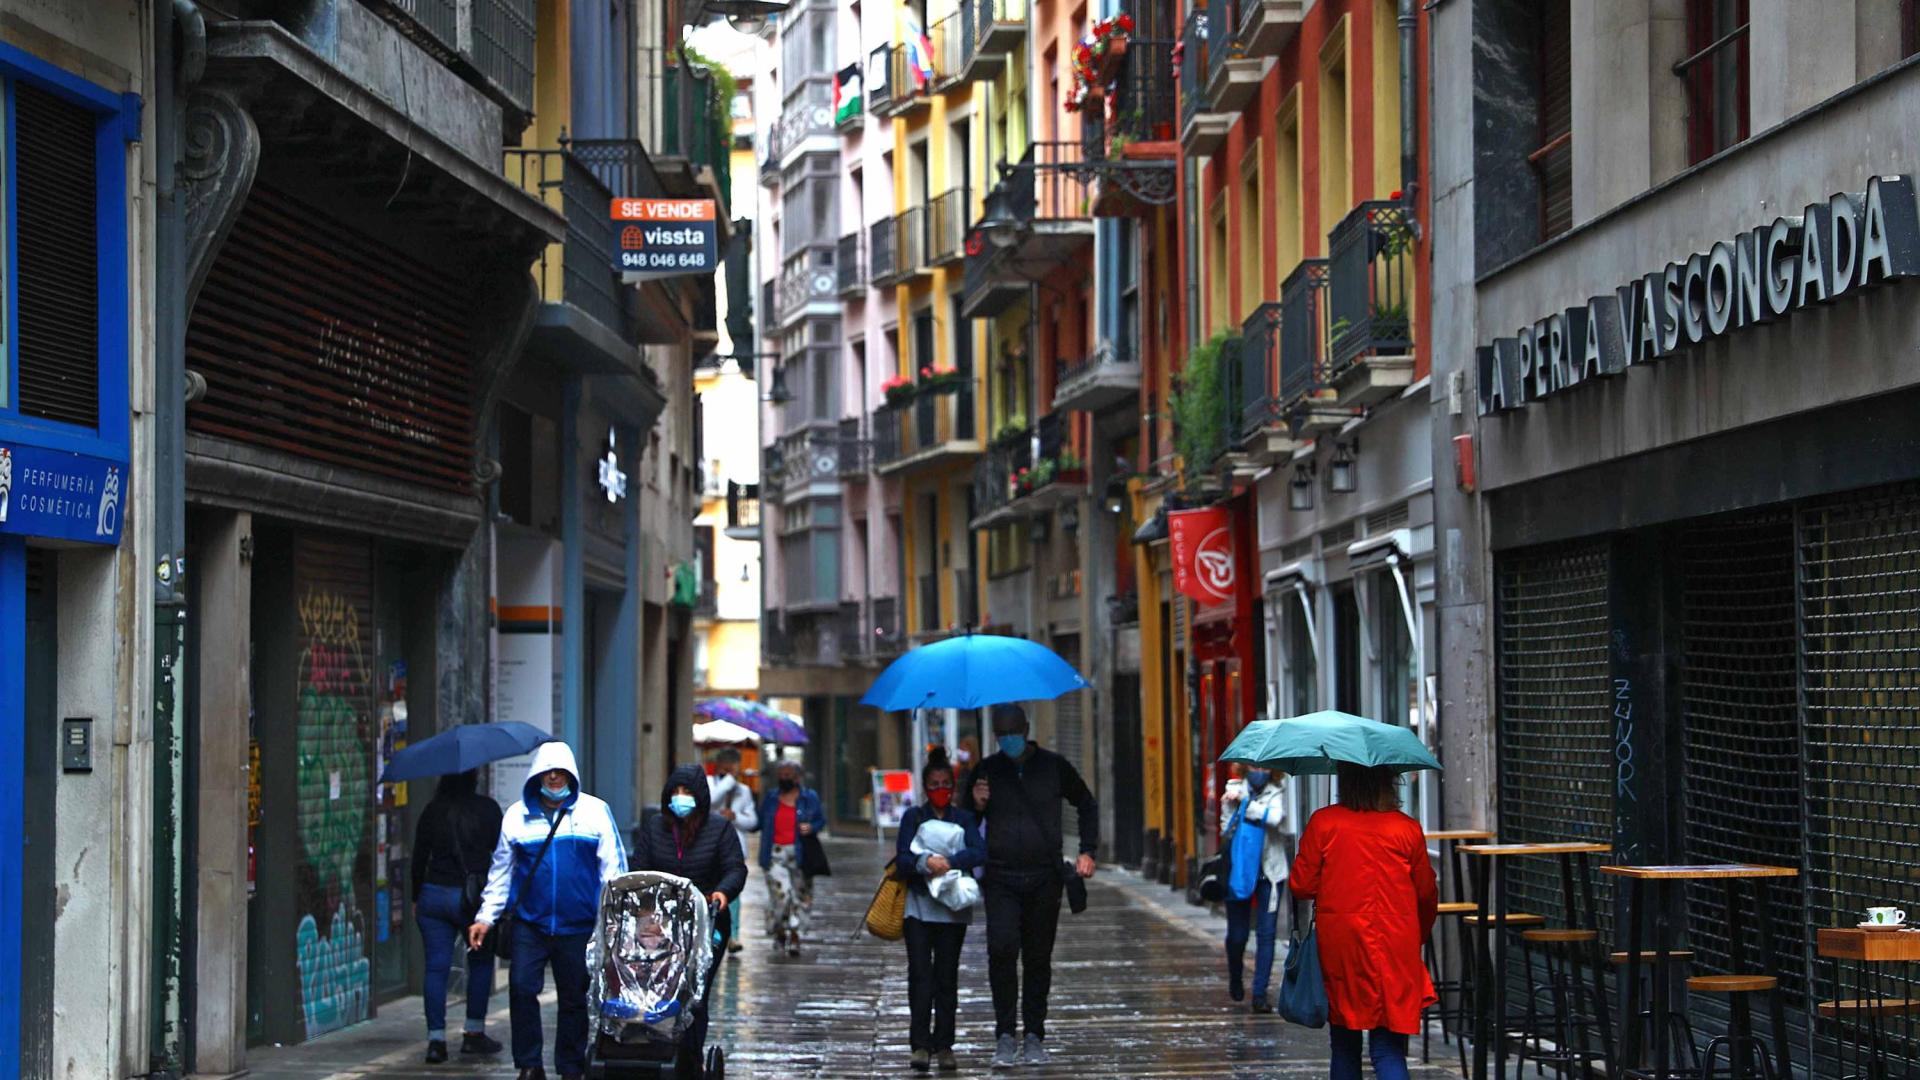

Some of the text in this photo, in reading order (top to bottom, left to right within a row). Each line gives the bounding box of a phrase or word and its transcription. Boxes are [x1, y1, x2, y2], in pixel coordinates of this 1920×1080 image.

[621, 202, 704, 218] SE VENDE
[644, 226, 705, 245] vissta
[622, 252, 705, 267] 948 046 648
[1477, 175, 1893, 417] LA PERLA VASCONGADA
[23, 468, 95, 495] PERFUMERÍA
[20, 494, 92, 519] COSMÉTICA
